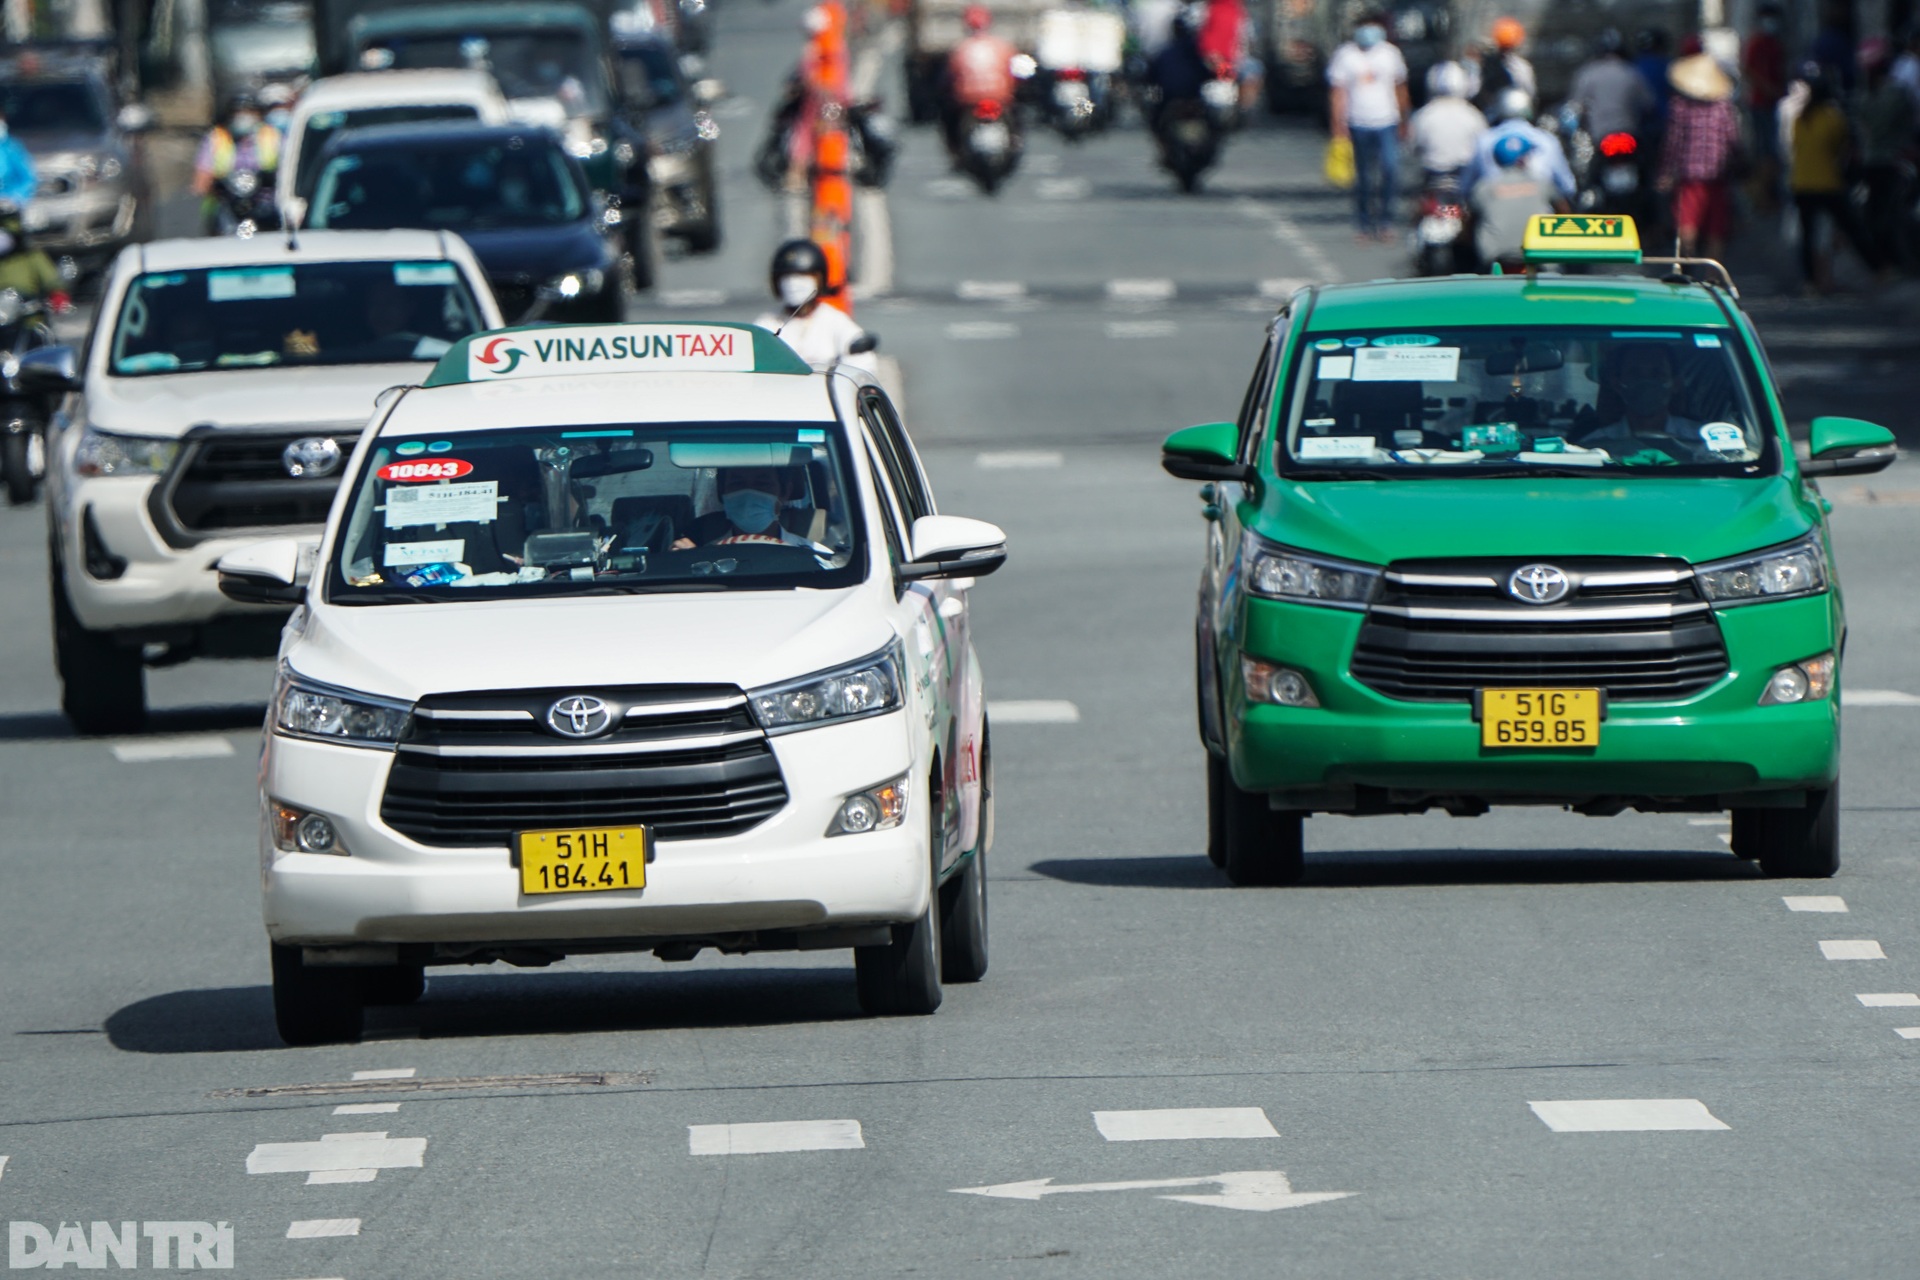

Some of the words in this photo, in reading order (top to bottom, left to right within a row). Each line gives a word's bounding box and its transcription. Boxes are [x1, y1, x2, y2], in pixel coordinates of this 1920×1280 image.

[388, 462, 458, 479] 10643
[1517, 693, 1565, 716] 51G
[1497, 720, 1585, 743] 659.85
[556, 833, 608, 859] 51H
[540, 861, 629, 889] 184.41
